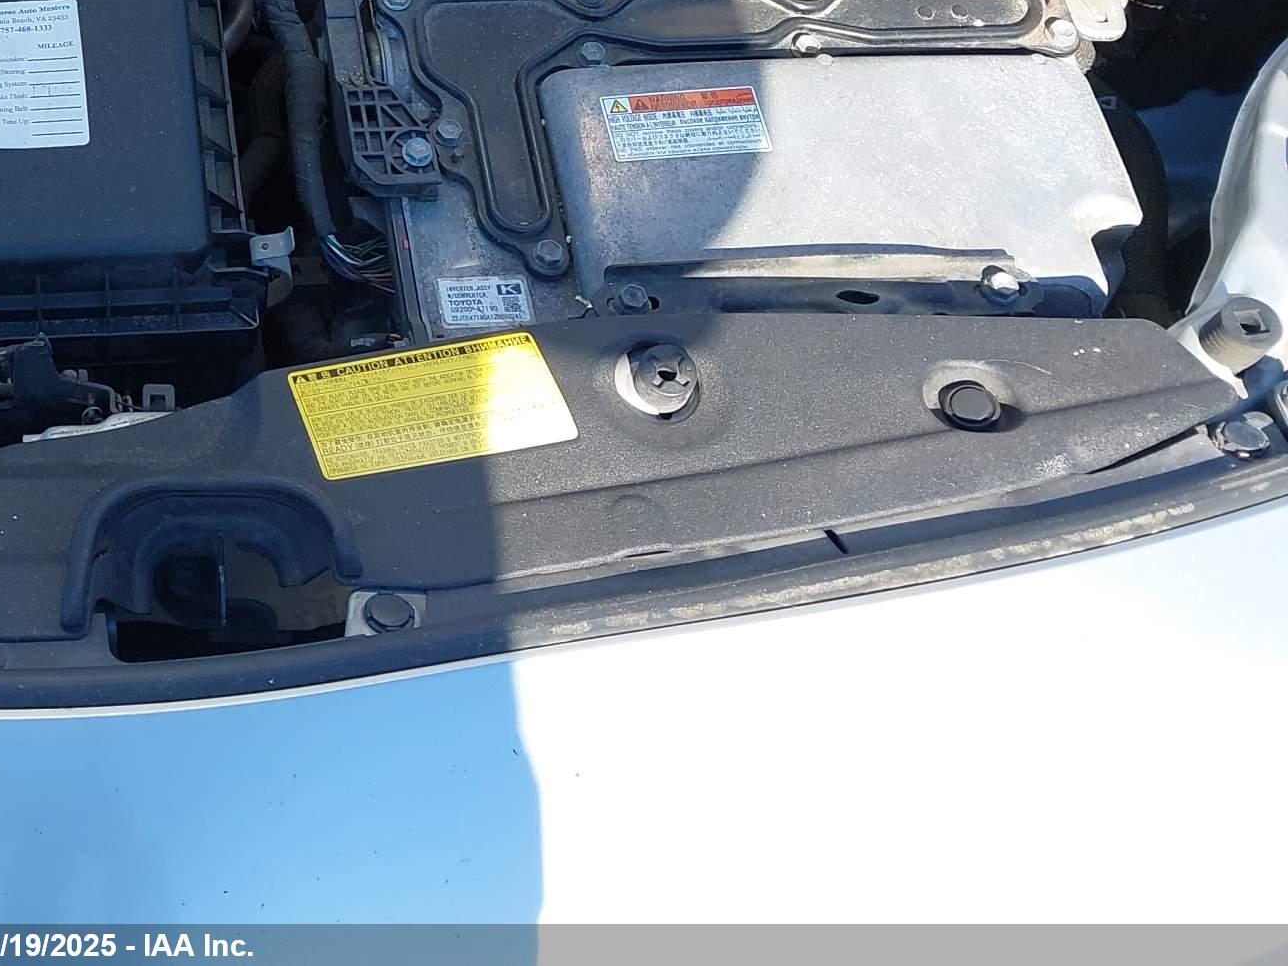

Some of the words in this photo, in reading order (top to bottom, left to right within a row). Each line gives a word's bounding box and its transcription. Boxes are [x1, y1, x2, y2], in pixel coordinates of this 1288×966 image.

[18, 7, 38, 15] Auto
[39, 4, 70, 13] Masters
[0, 25, 52, 34] 757-468-1333
[37, 41, 74, 49] MILEAGE
[464, 335, 529, 353] ВНИМАНИЕ
[337, 360, 388, 375] CAUTION
[394, 346, 460, 365] ATTENTION
[321, 443, 353, 455] READY
